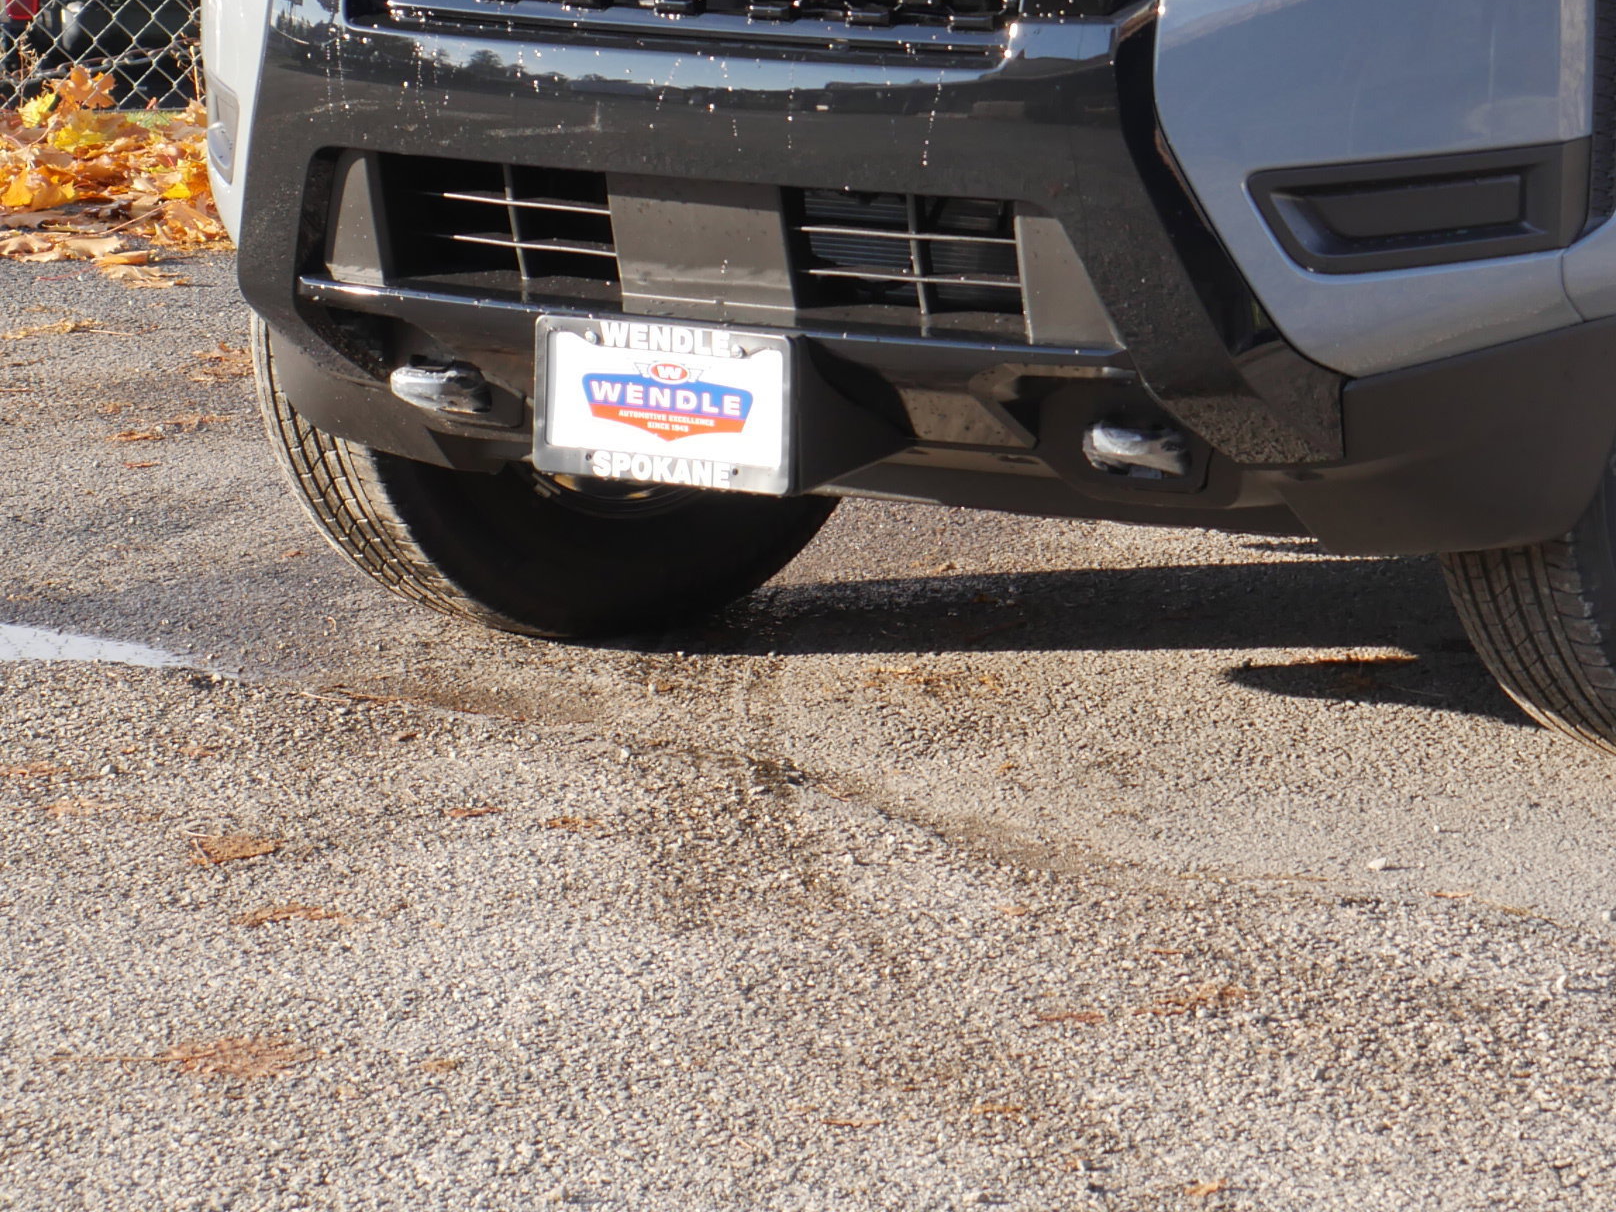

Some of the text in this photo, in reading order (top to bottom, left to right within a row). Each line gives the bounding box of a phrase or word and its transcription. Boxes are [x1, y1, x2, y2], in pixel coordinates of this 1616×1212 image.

[600, 322, 731, 357] WENDLE
[591, 380, 741, 416] WENDLE
[618, 409, 716, 427] AUTOMOTIVE EXCELLENCE
[647, 421, 671, 431] SINCE
[592, 451, 730, 488] SPOKANE
